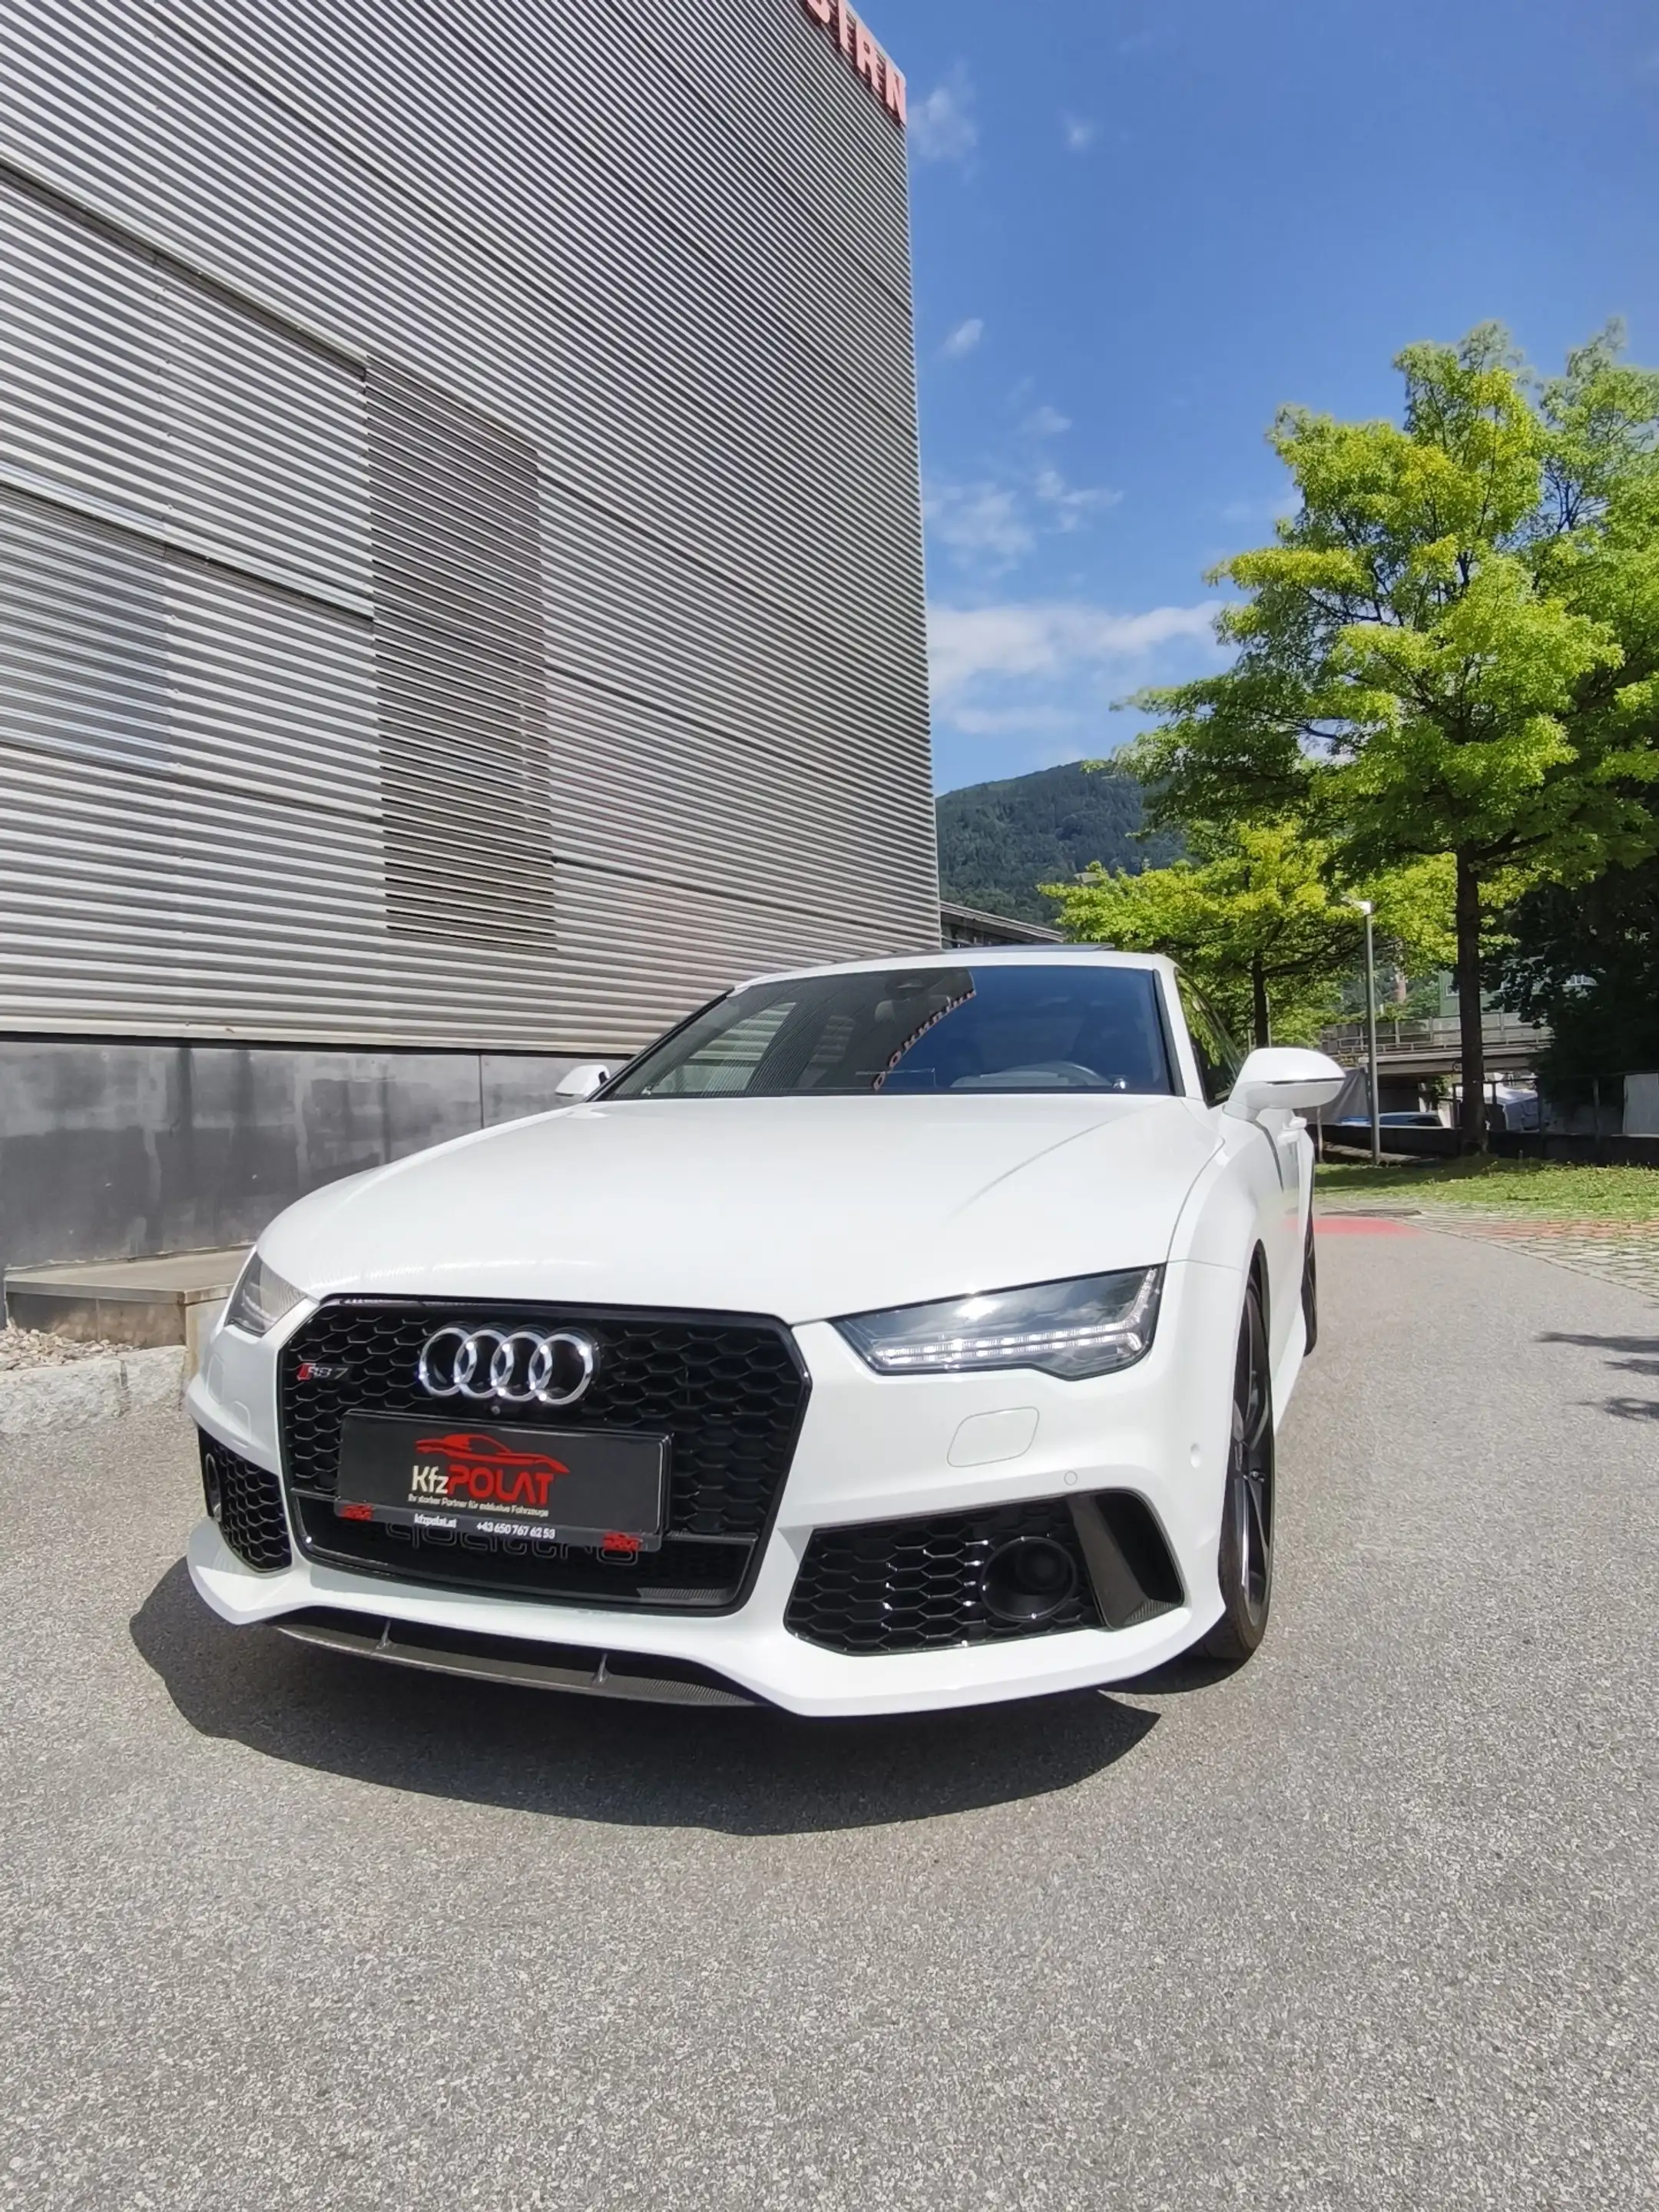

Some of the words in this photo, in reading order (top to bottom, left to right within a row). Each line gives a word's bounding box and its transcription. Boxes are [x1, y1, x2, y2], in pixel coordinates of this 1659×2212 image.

[806, 0, 907, 128] IRN
[441, 1497, 467, 1508] Partner
[468, 1499, 478, 1508] für
[511, 1505, 549, 1518] Fahrzeuge
[414, 1512, 457, 1528] kfzpolat.at
[476, 1522, 494, 1532] +43
[494, 1523, 512, 1535] 650
[512, 1525, 529, 1536] 767
